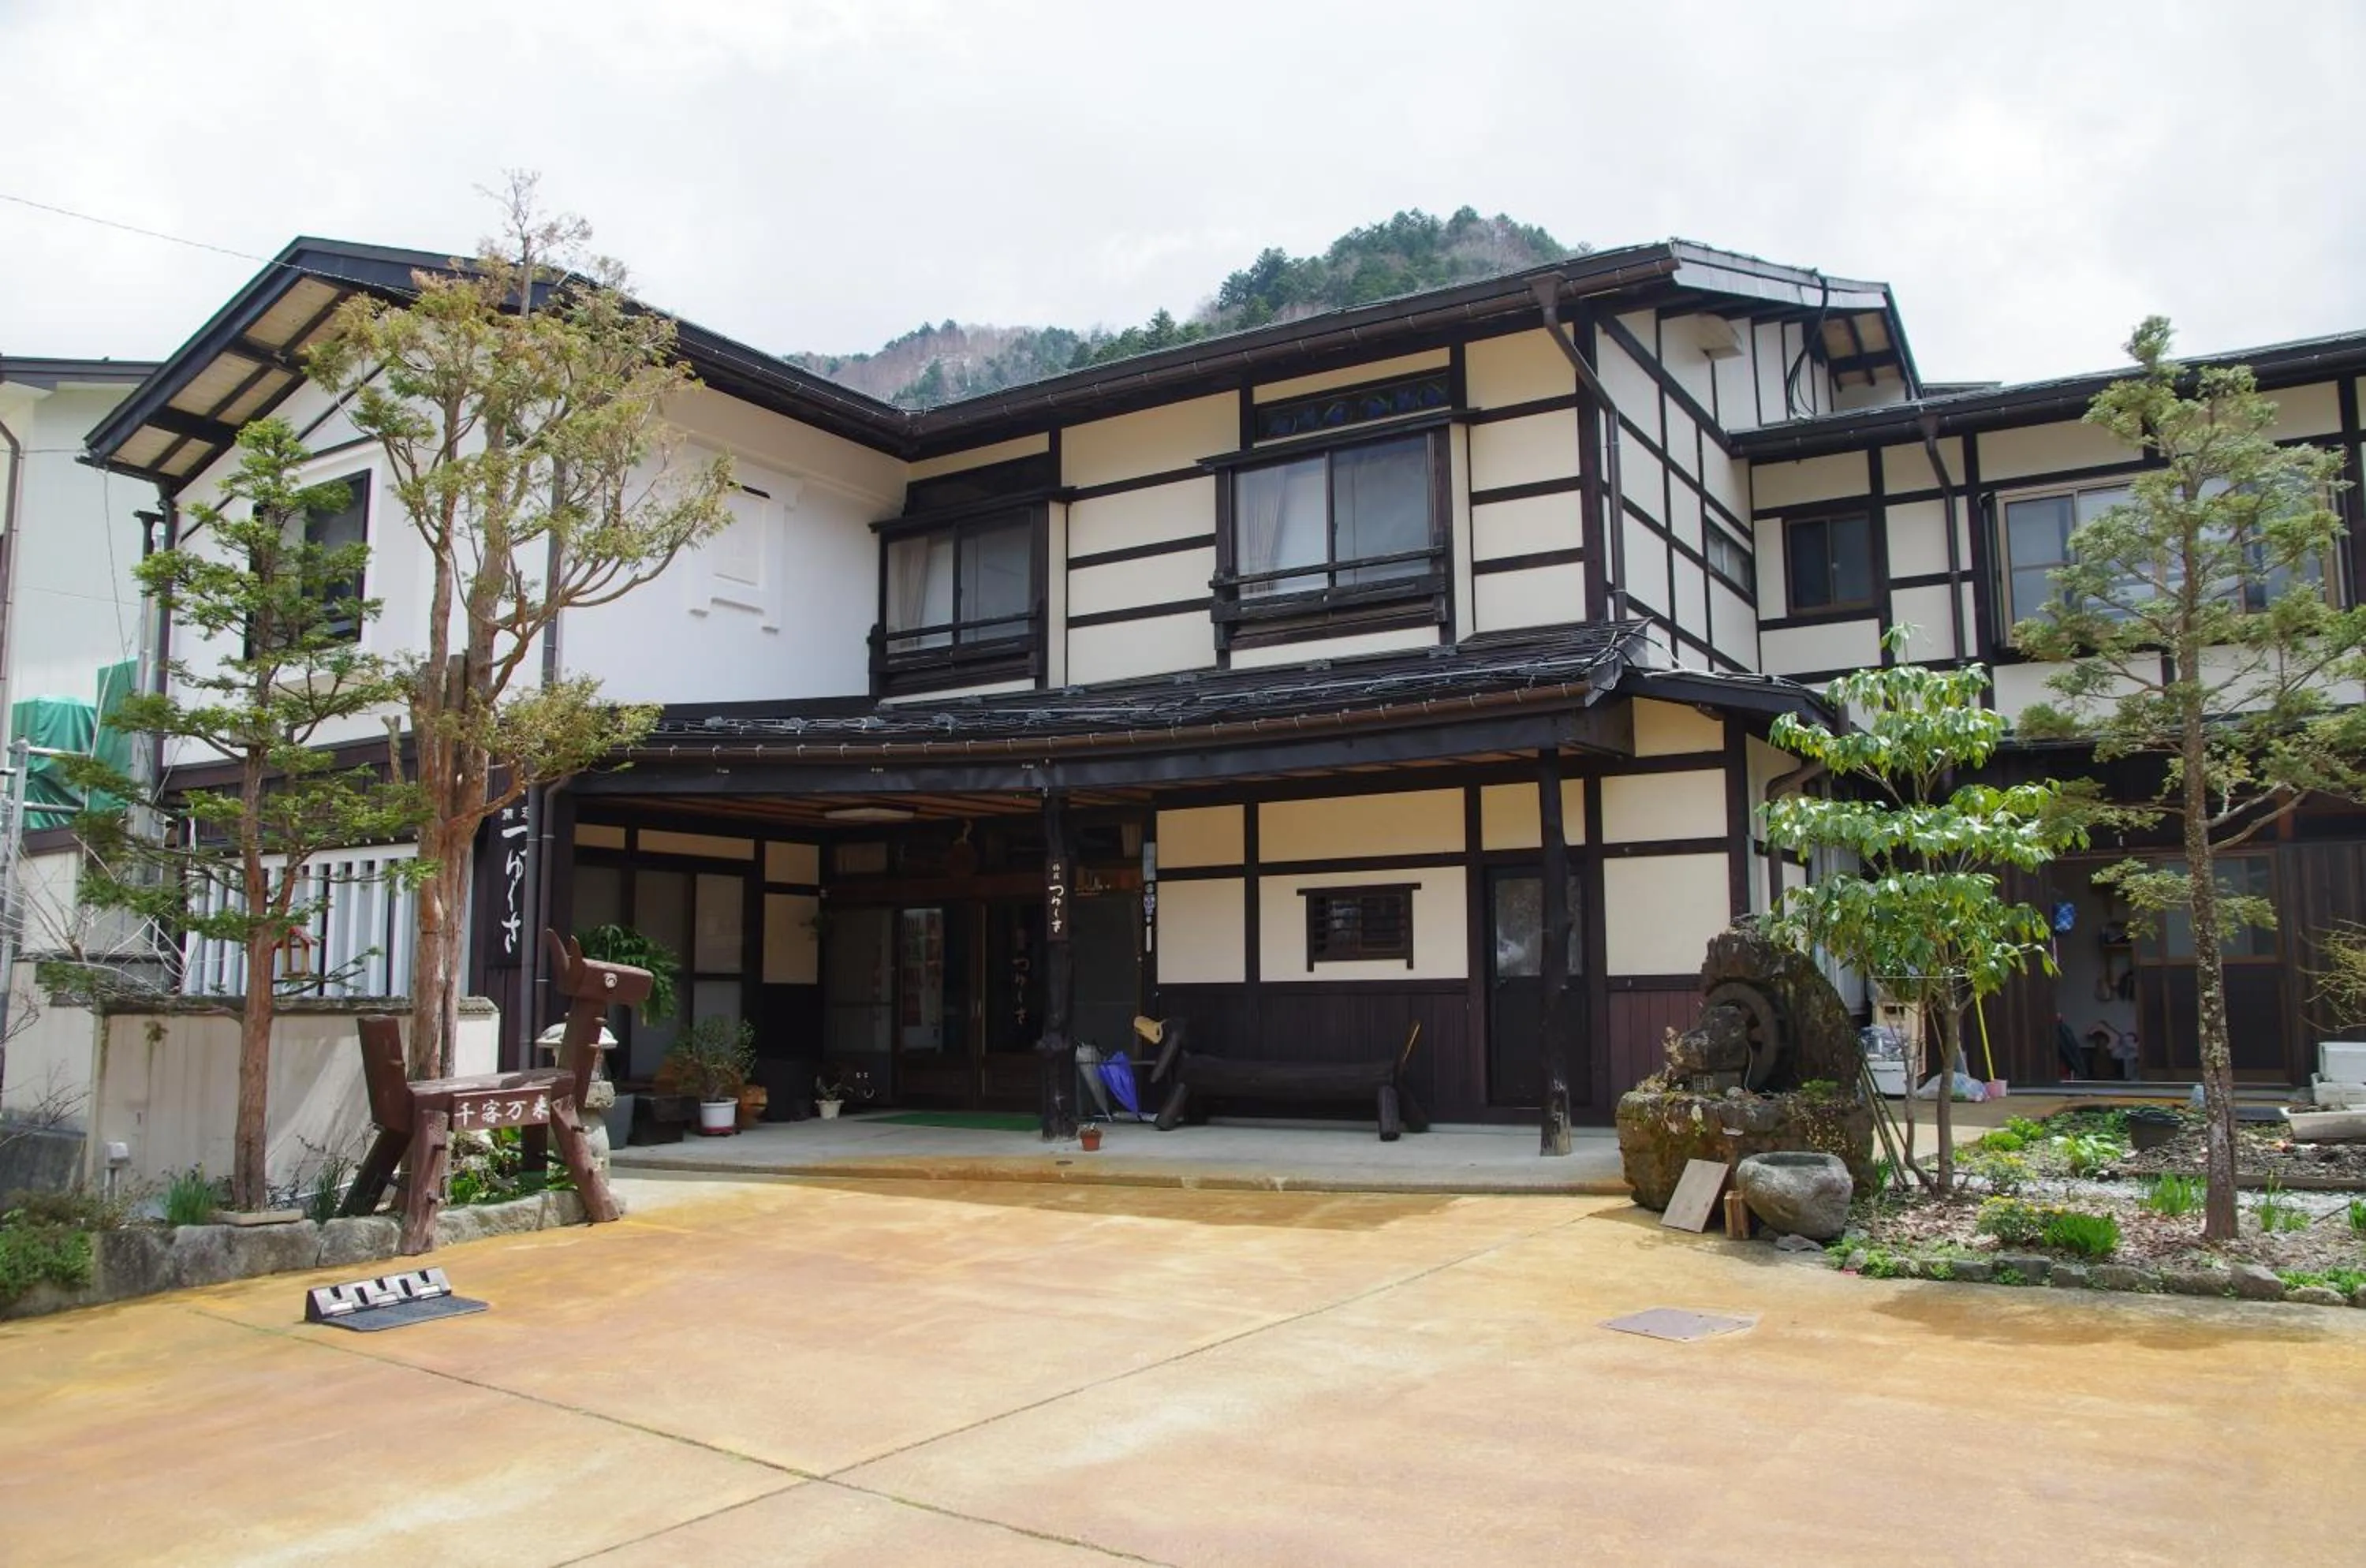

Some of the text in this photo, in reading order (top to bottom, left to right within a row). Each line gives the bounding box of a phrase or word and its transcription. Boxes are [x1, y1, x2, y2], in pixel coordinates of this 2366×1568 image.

[1048, 884, 1064, 933] つゆくさ
[454, 1095, 550, 1127] 千客万来
